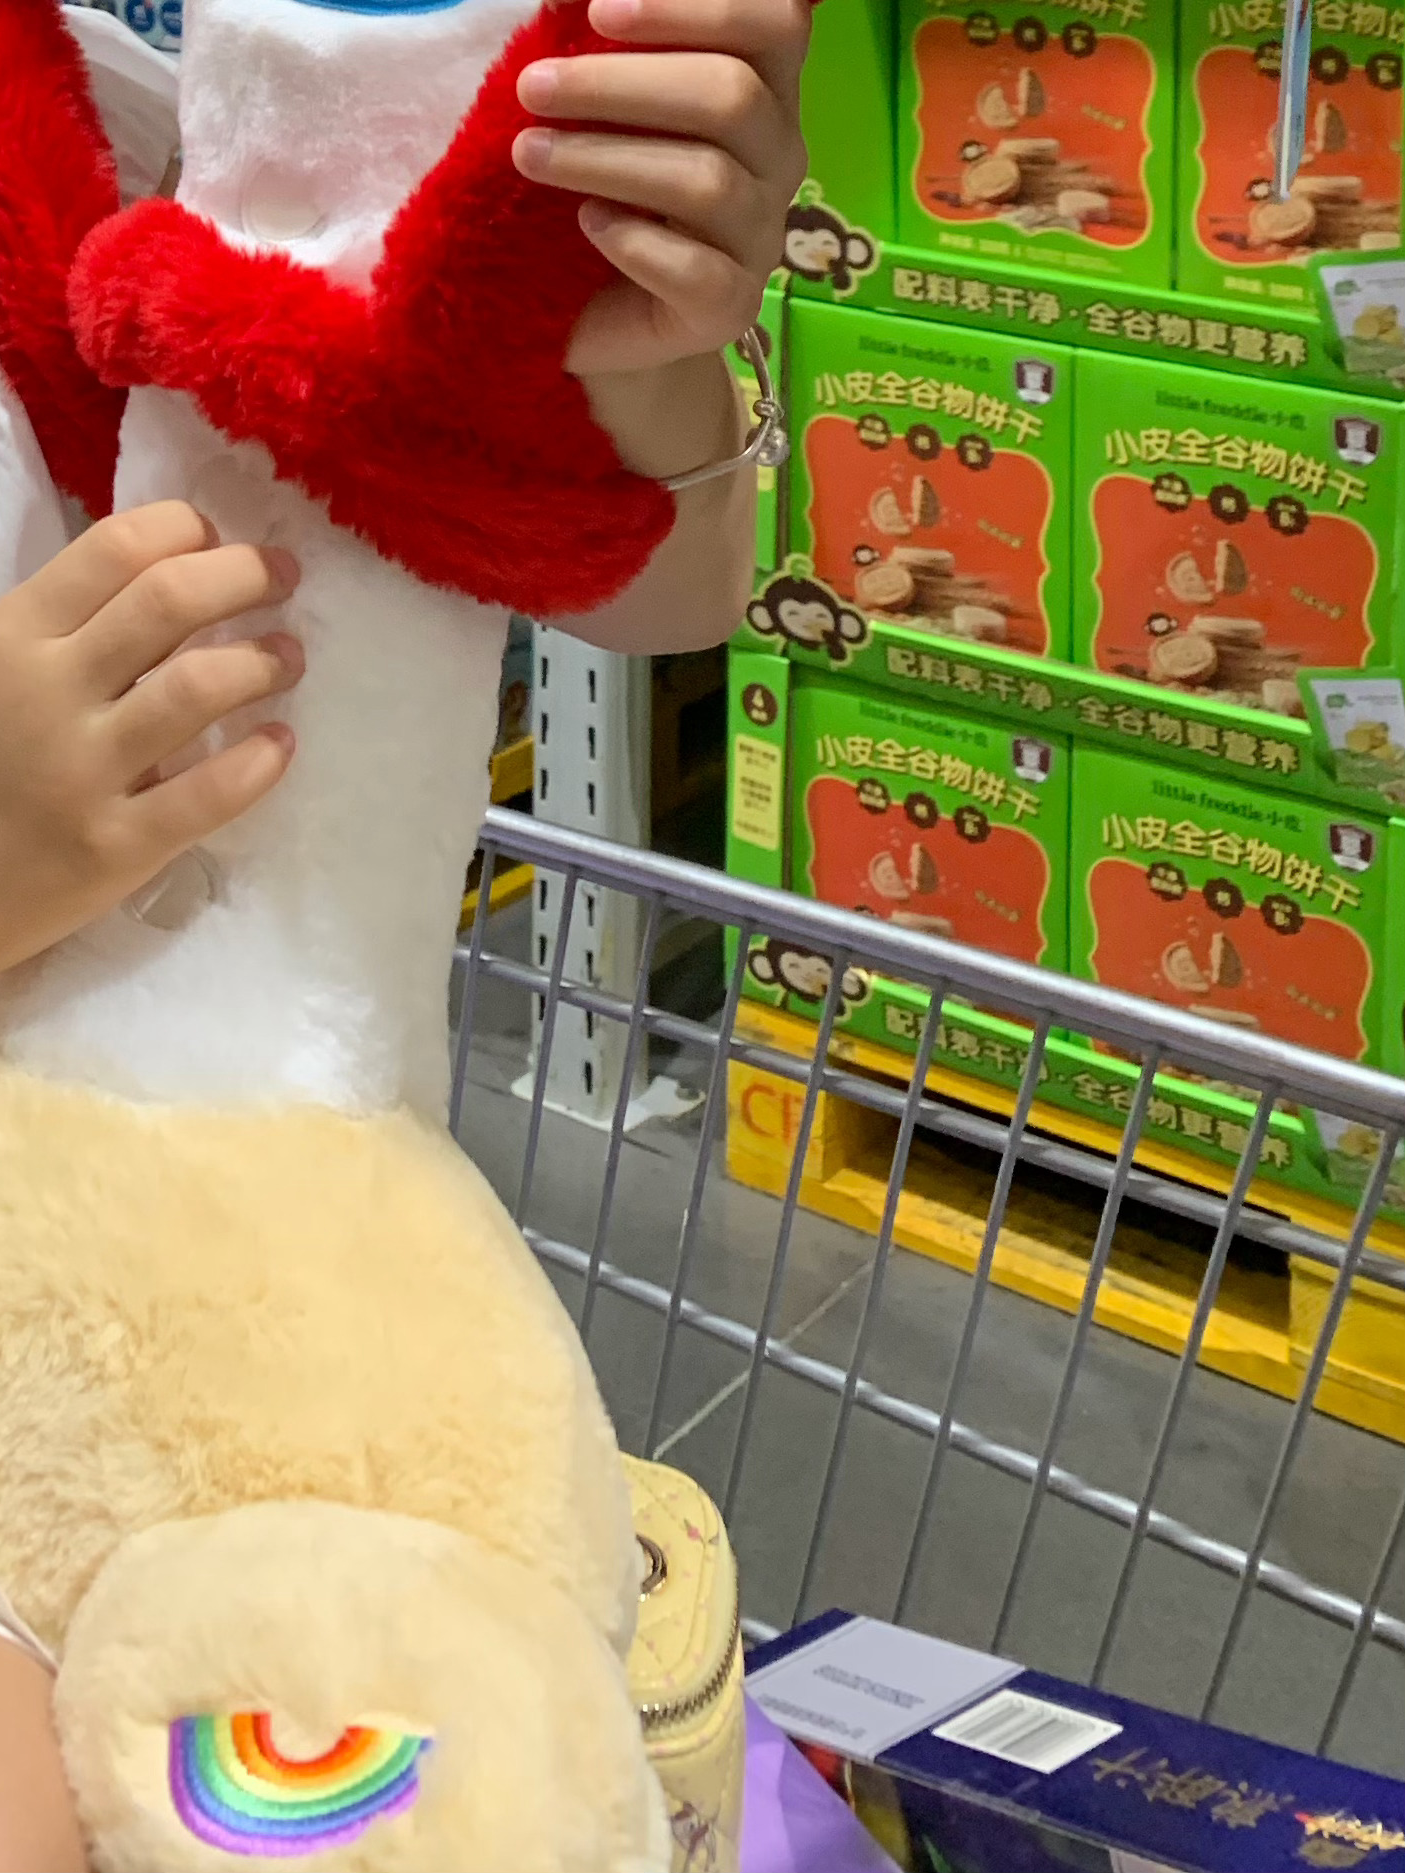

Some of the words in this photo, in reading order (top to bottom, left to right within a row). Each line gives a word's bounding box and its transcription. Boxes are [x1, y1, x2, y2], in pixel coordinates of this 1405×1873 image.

[816, 371, 1043, 444] 小皮全谷物饼干
[1106, 428, 1367, 507] 小皮全谷物饼干
[817, 735, 1040, 820] 小皮全谷物饼干
[1102, 814, 1362, 911] 小皮全谷物饼干
